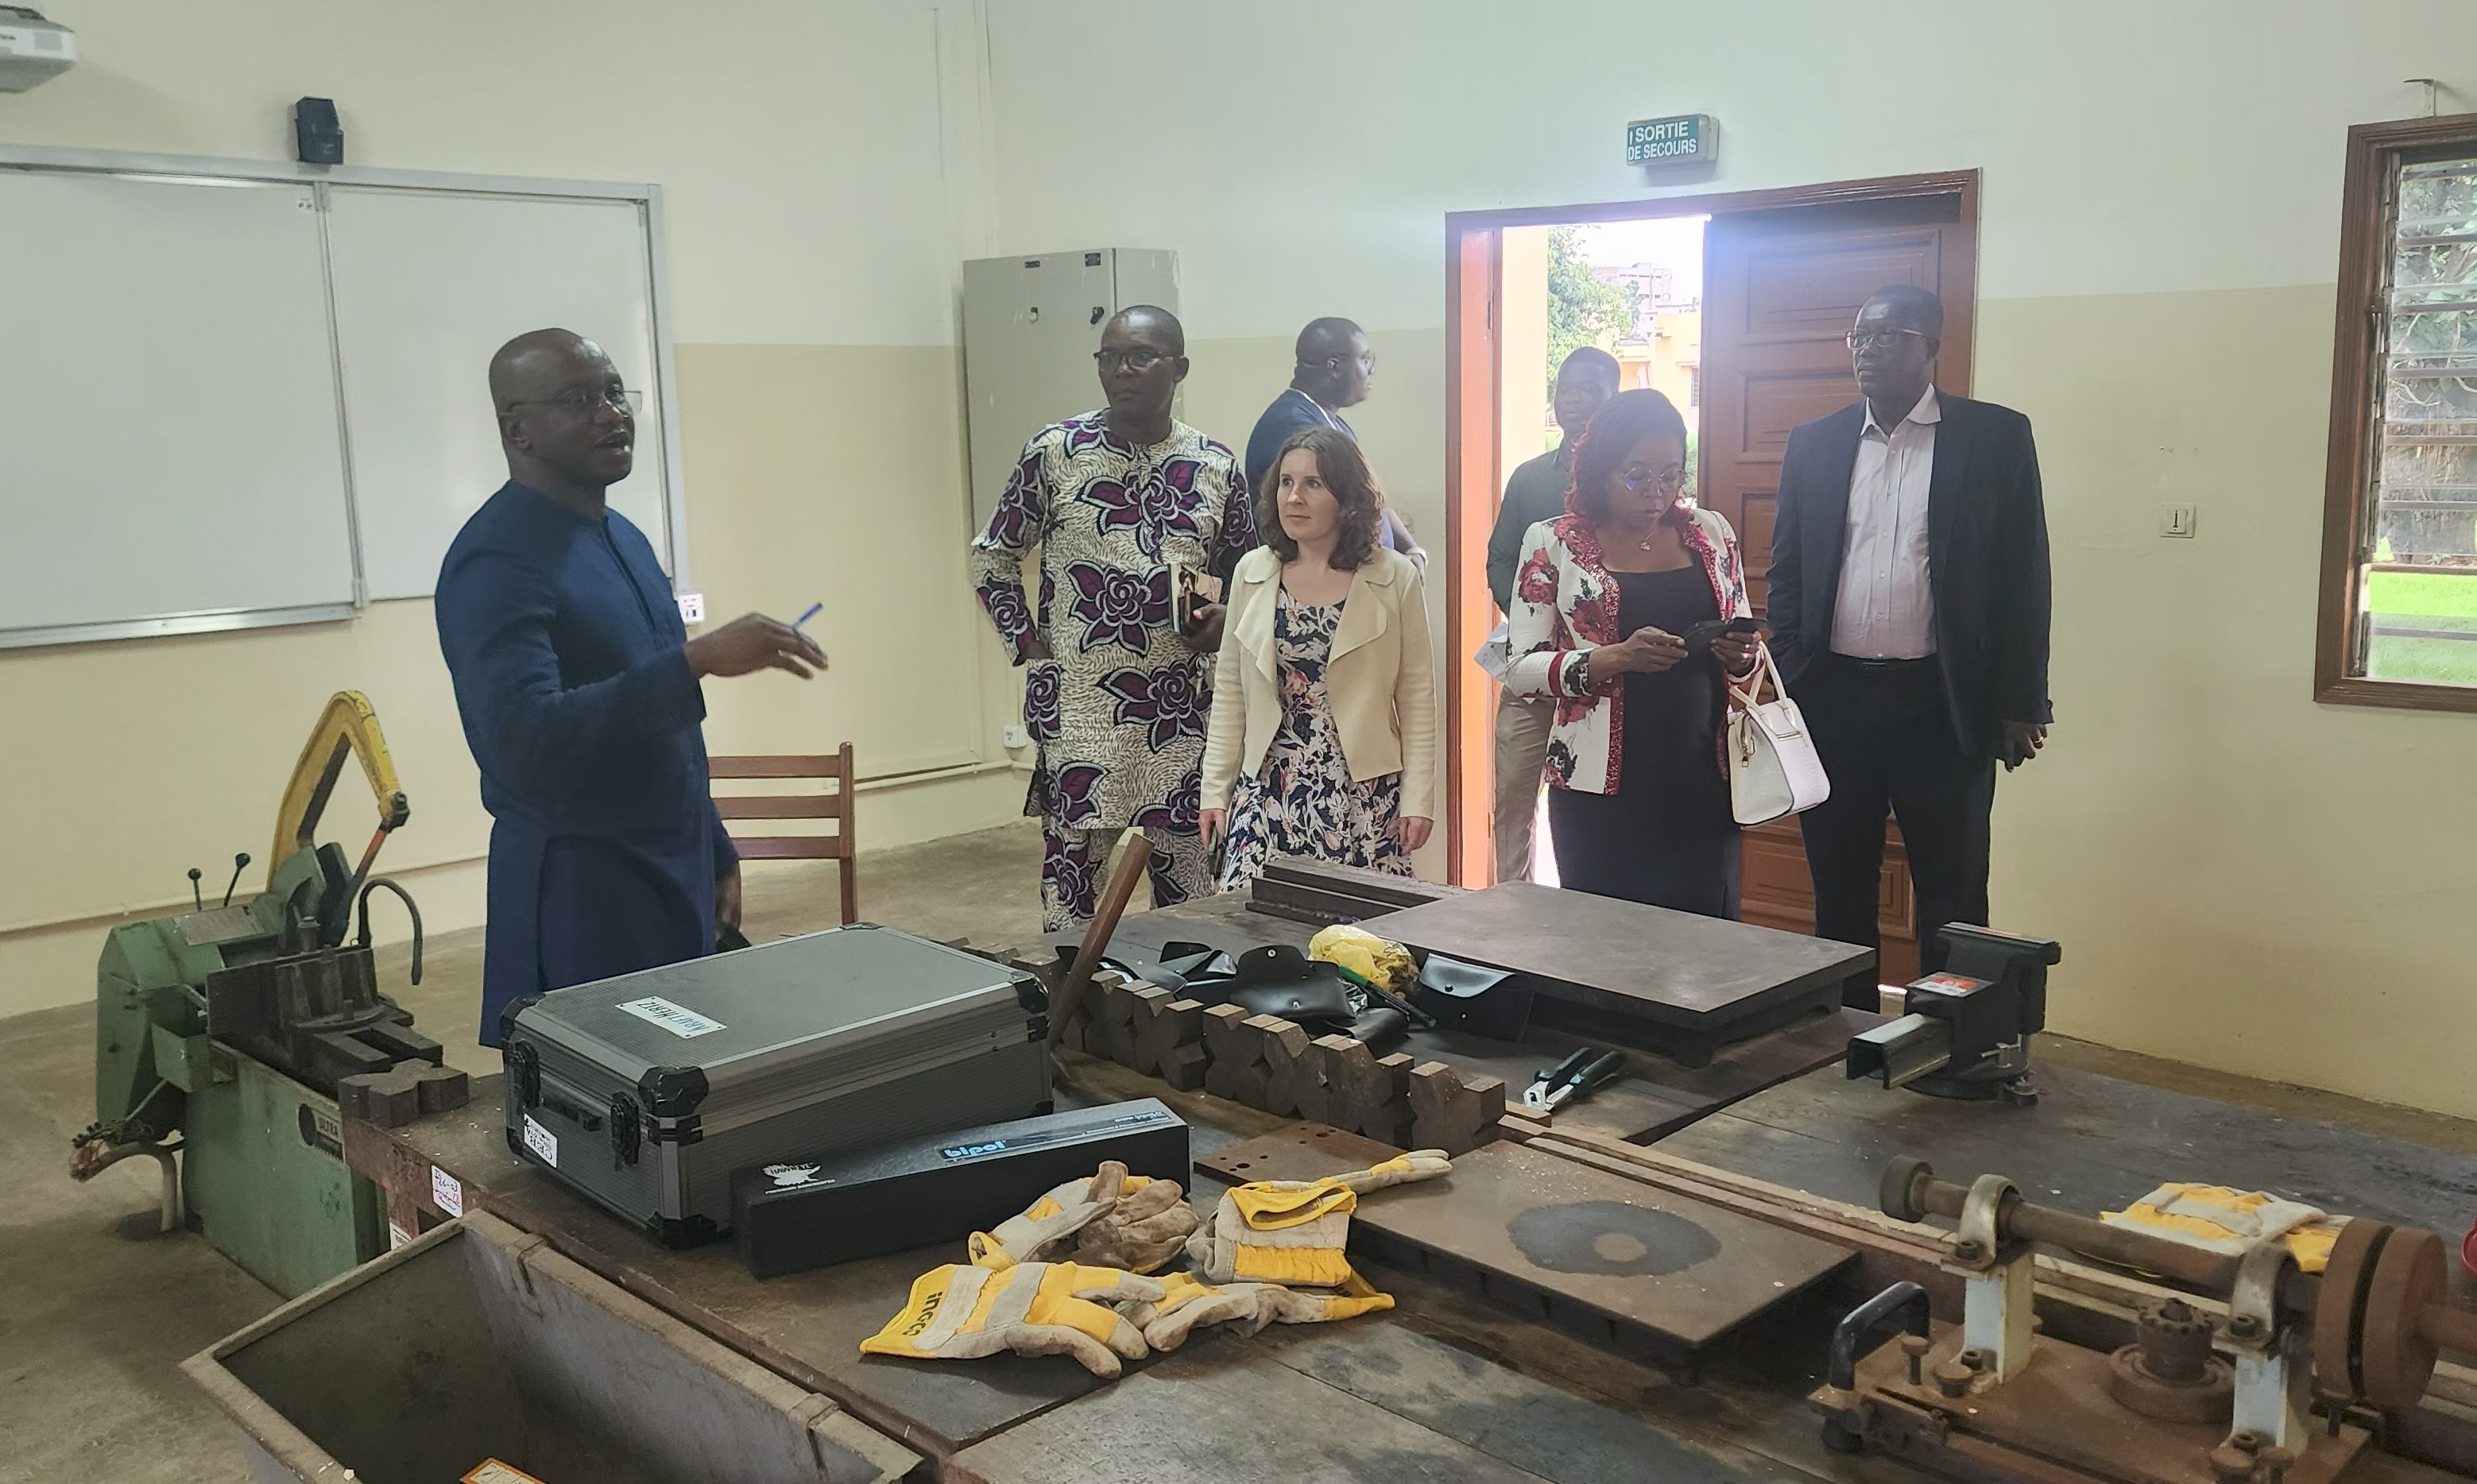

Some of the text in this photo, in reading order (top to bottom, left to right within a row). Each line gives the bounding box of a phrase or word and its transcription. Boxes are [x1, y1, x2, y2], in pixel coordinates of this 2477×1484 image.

[1635, 121, 1689, 143] SORTIE
[1627, 138, 1697, 160] DE SECOURS
